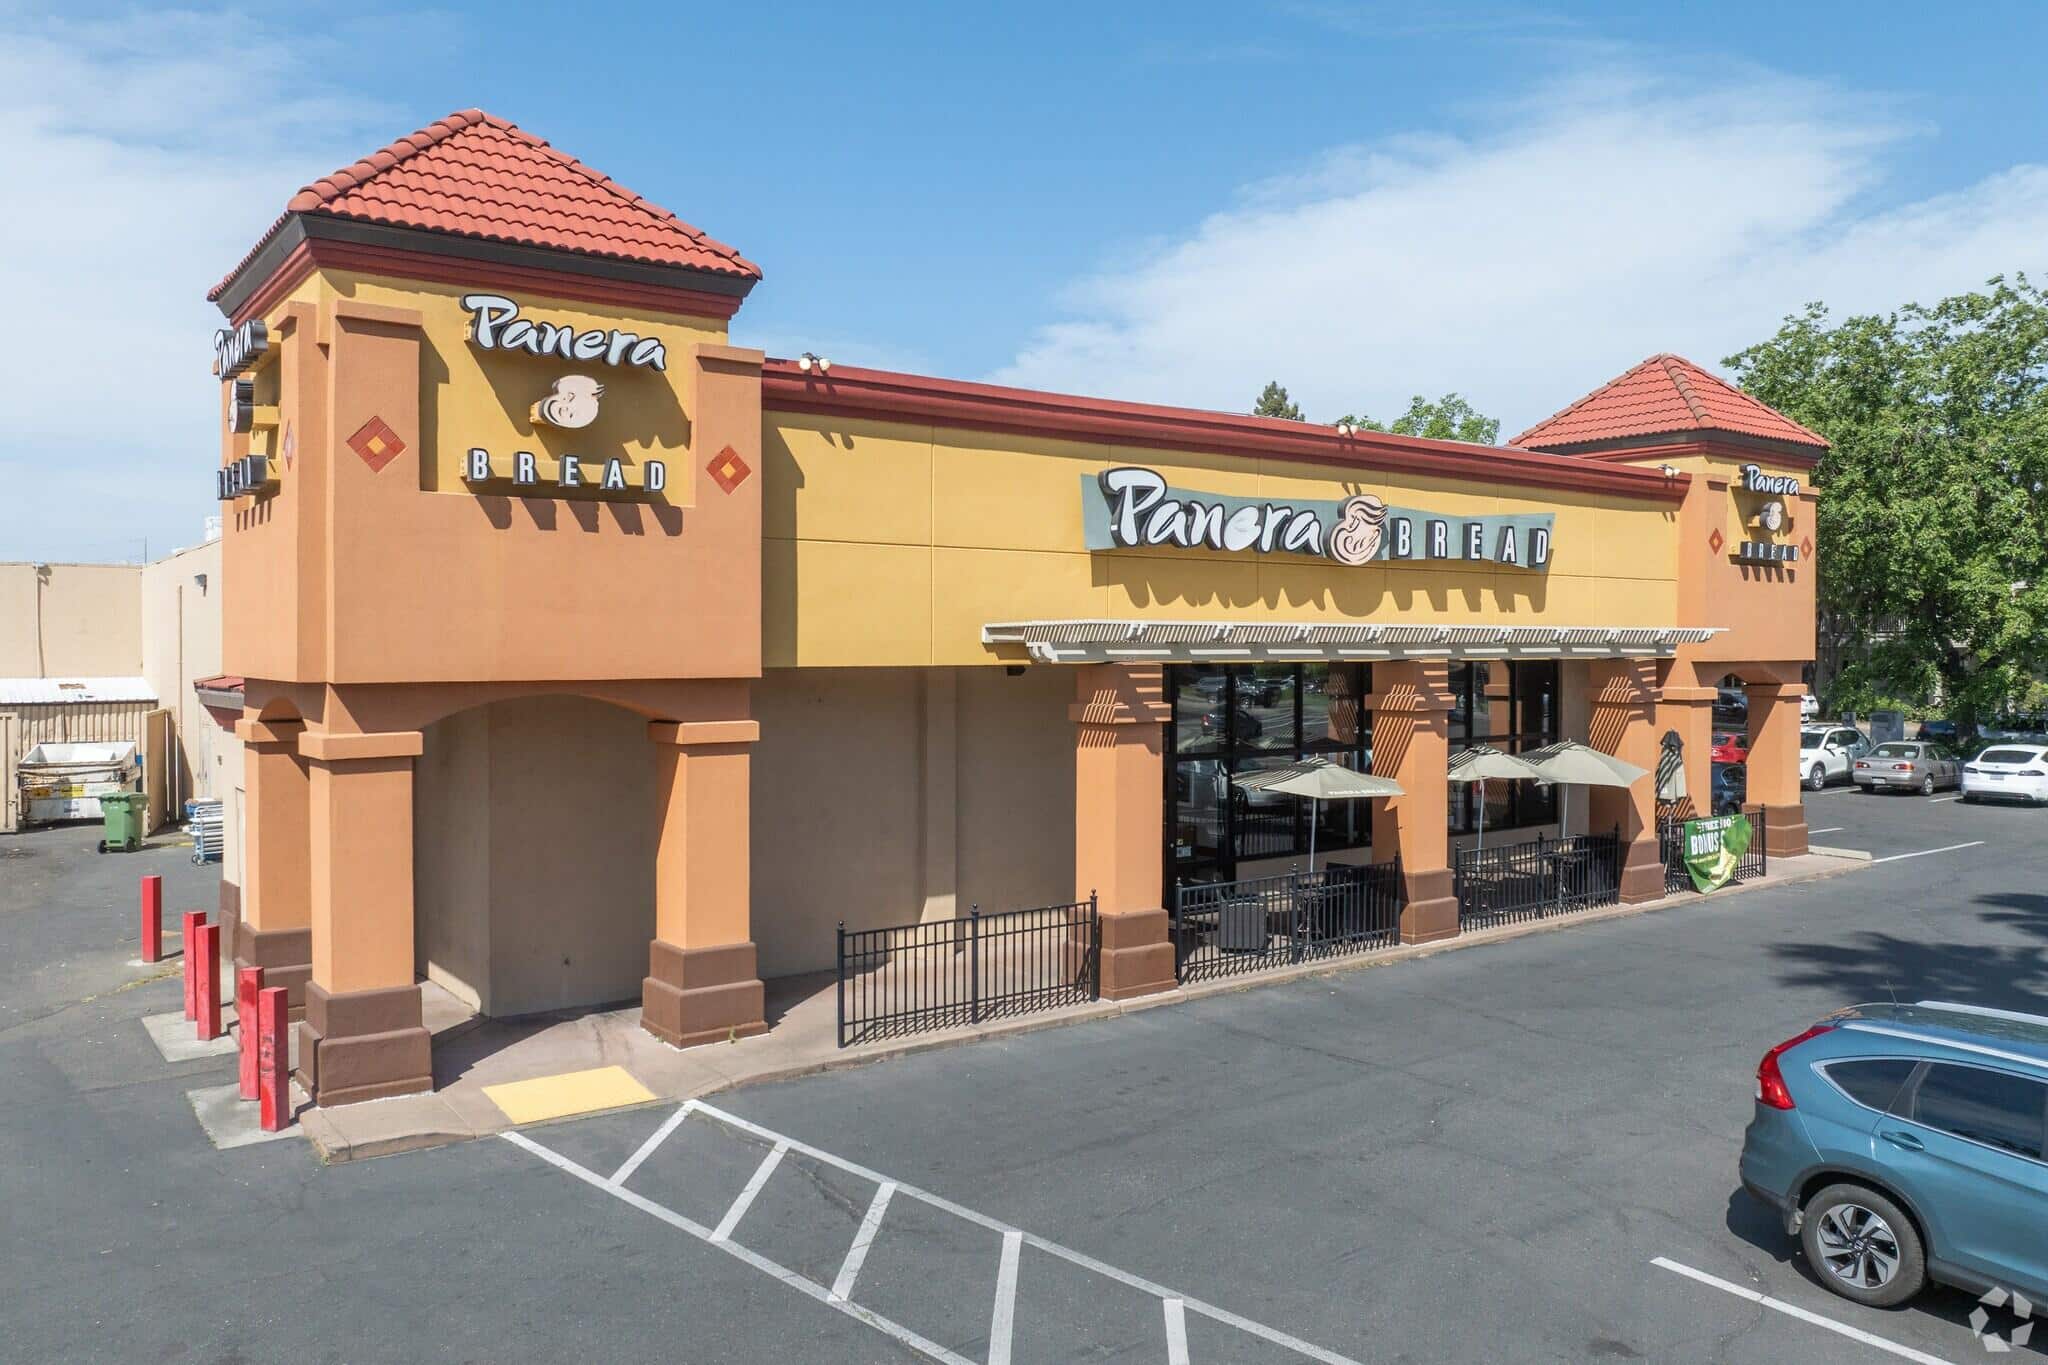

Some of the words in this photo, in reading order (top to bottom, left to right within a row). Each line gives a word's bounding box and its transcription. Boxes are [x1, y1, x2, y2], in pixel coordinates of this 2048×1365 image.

[461, 294, 667, 372] Panera
[467, 448, 667, 492] BREAD
[1745, 463, 1800, 496] Panera
[1098, 467, 1323, 556] Panera
[1390, 517, 1550, 568] BREAD
[1744, 541, 1799, 561] BREAD
[1690, 831, 1719, 856] BONUS
